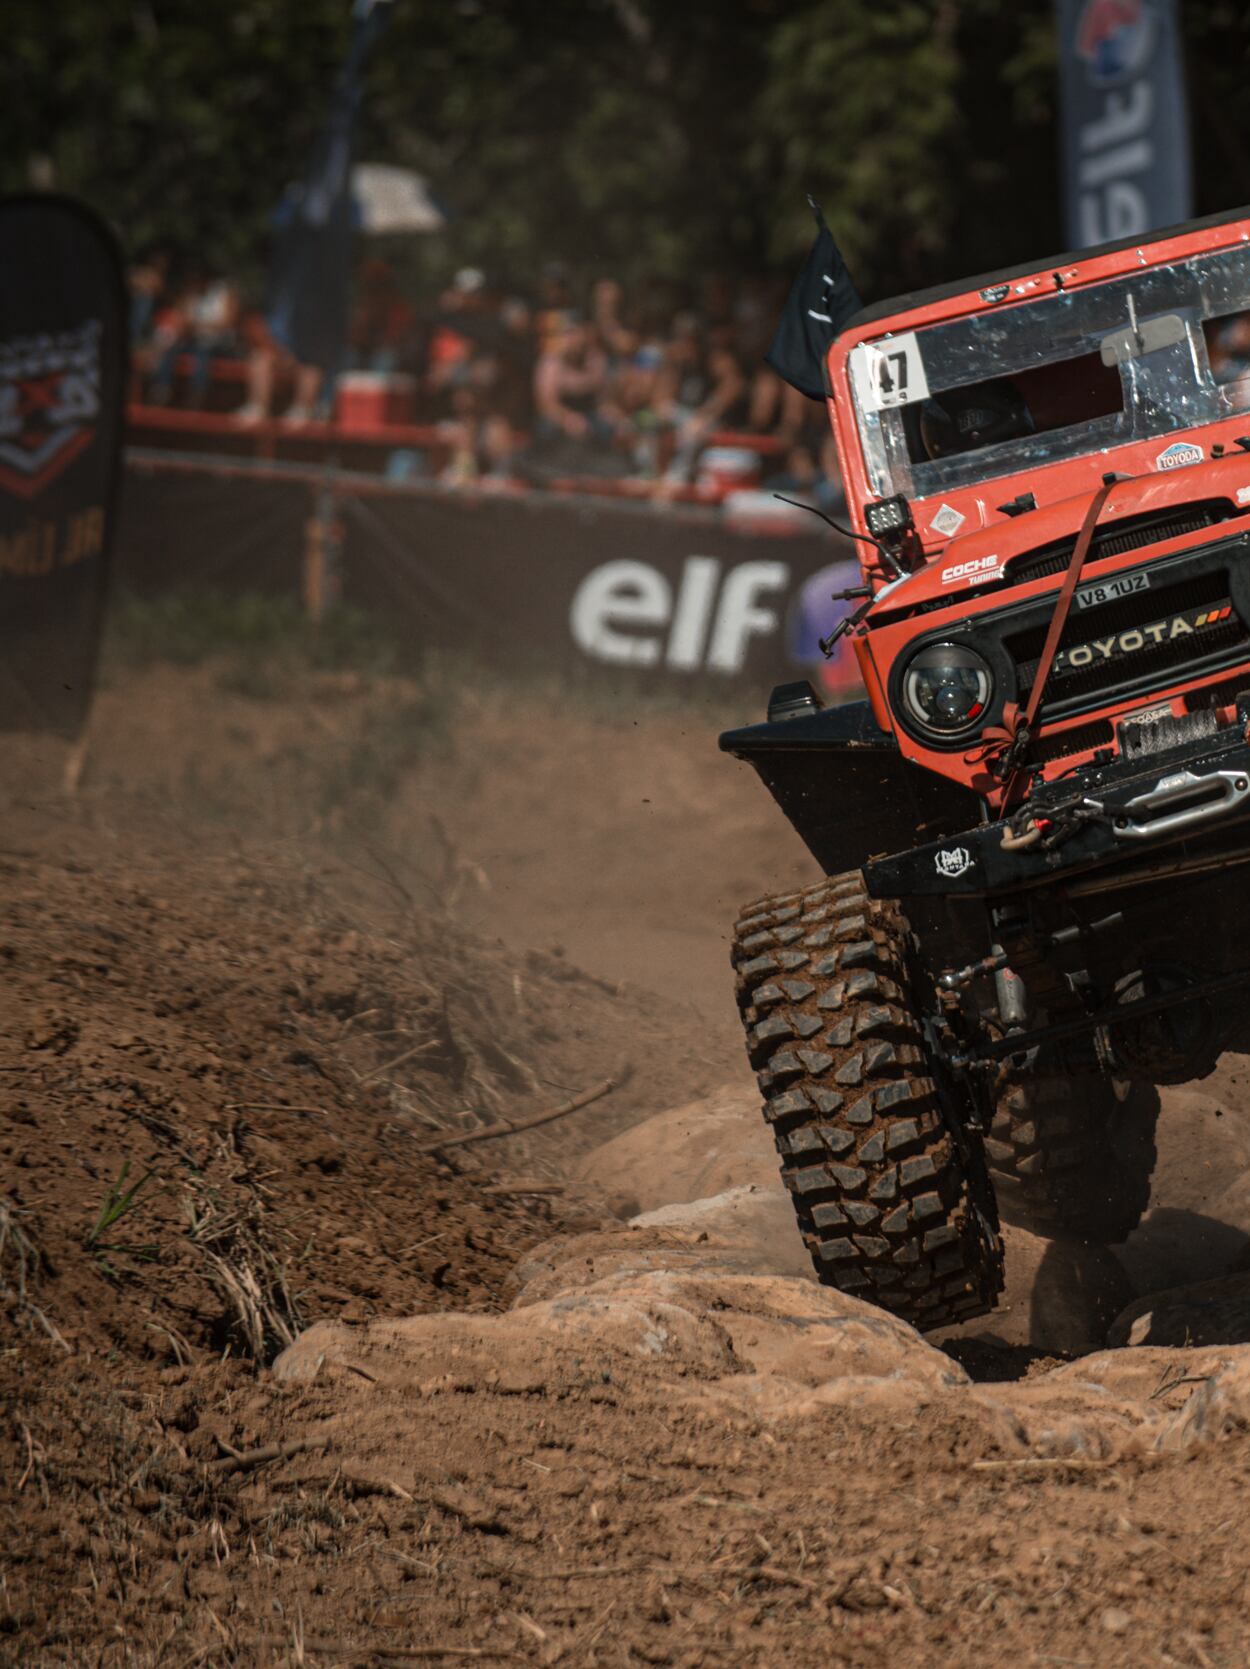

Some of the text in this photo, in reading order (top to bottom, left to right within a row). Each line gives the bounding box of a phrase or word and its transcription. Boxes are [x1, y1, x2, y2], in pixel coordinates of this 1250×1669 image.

[1161, 449, 1199, 468] TOYODA
[1080, 576, 1147, 607] V8 1UZ
[570, 555, 789, 674] elf
